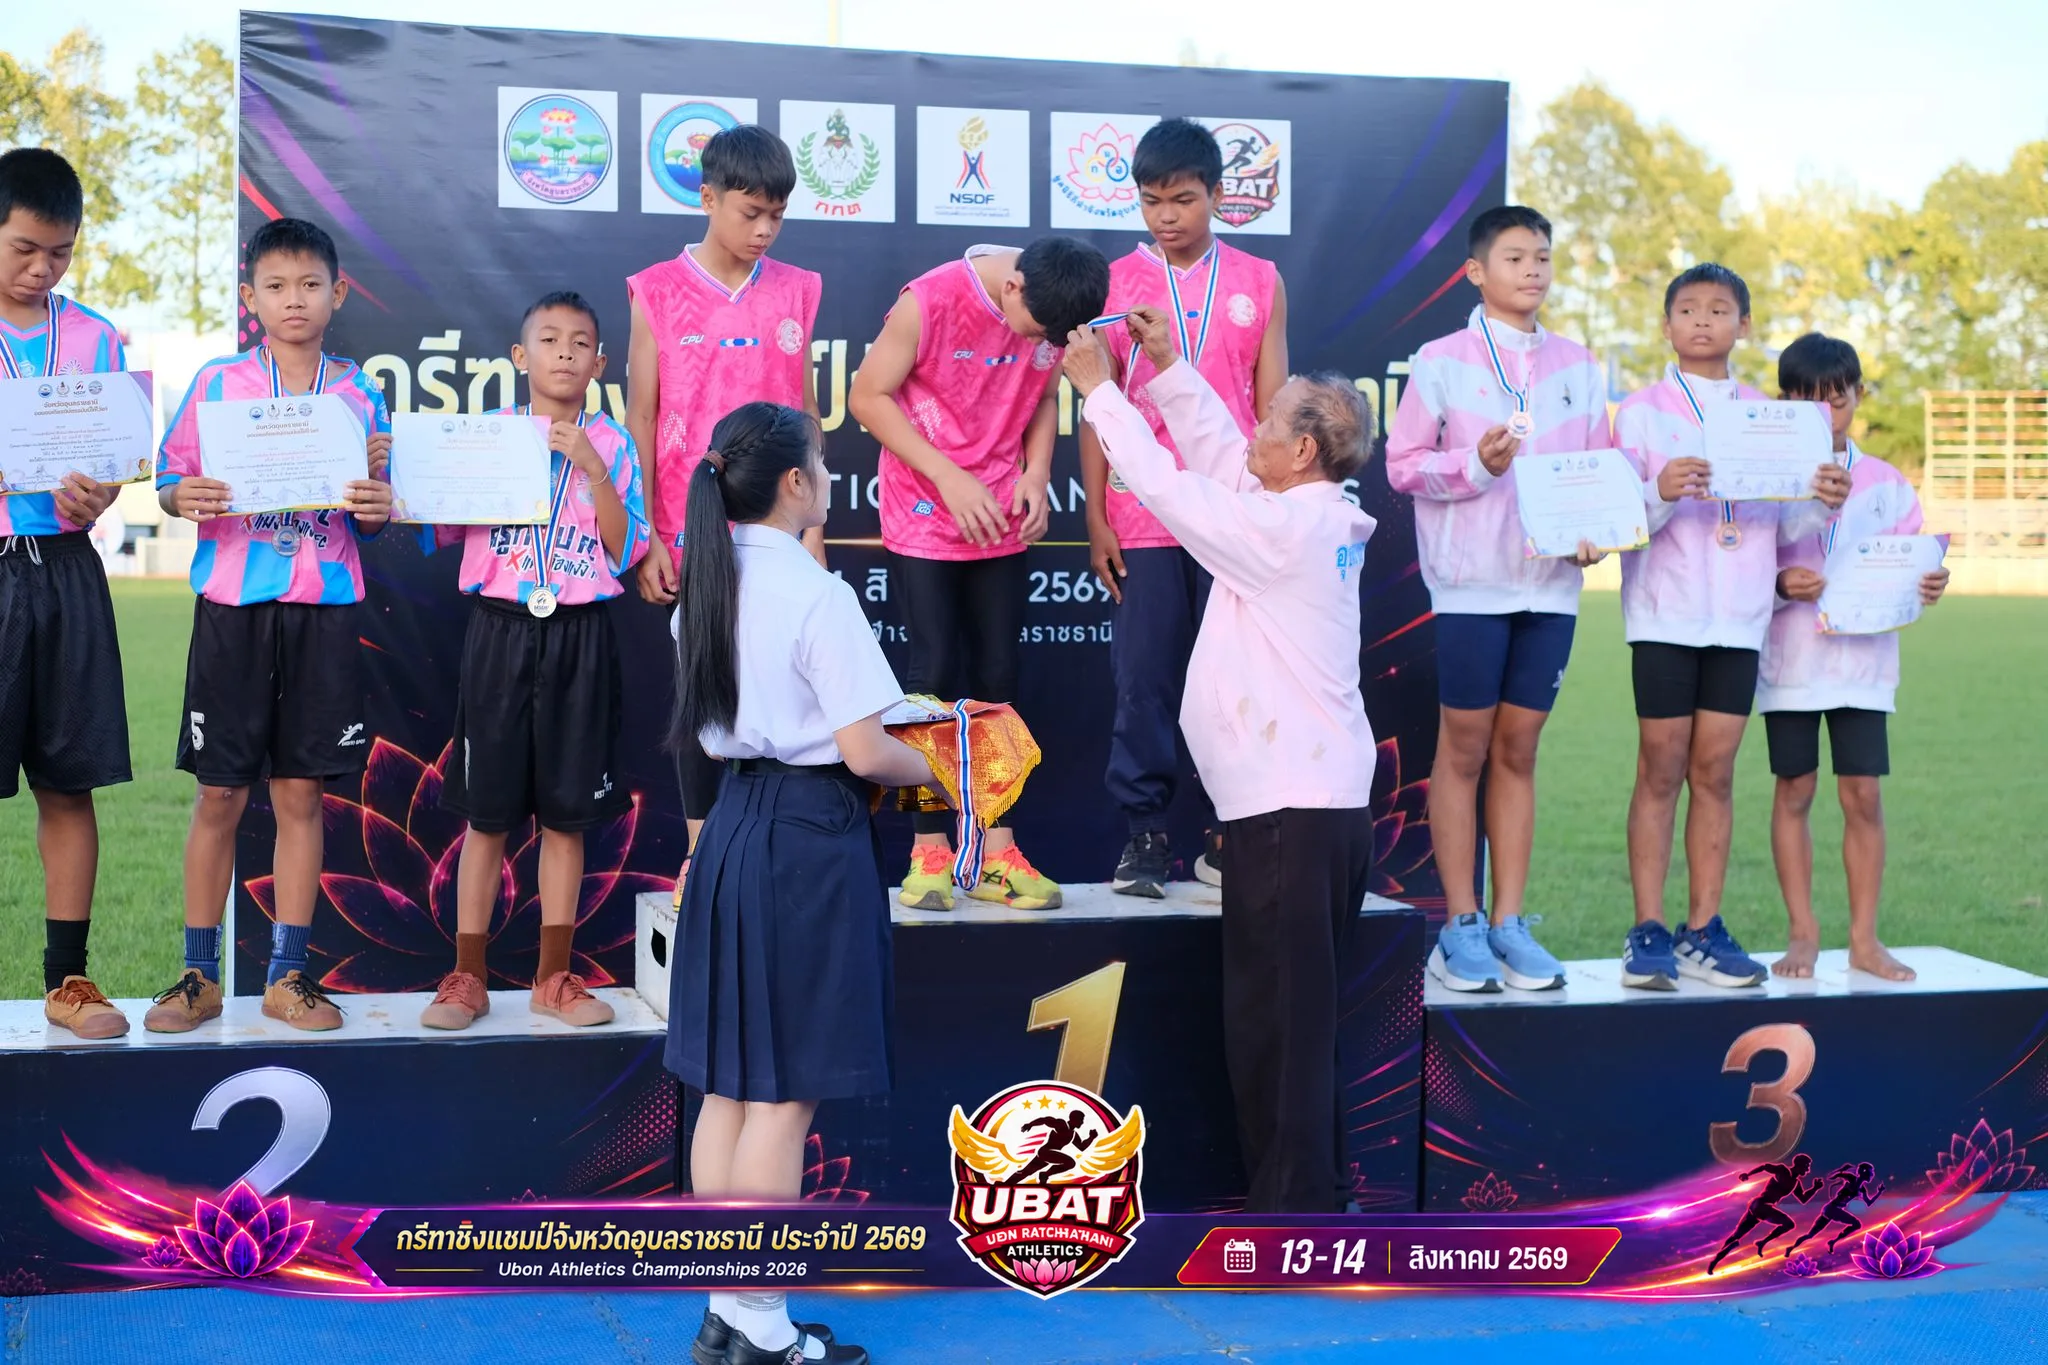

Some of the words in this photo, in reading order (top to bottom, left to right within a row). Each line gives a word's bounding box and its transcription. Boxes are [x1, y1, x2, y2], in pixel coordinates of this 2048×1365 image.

[949, 192, 996, 205] NSDF
[1221, 178, 1275, 199] BAT
[190, 711, 205, 751] 5
[1027, 962, 1127, 1096] 1
[191, 1066, 332, 1198] 2
[1709, 1023, 1816, 1166] 3
